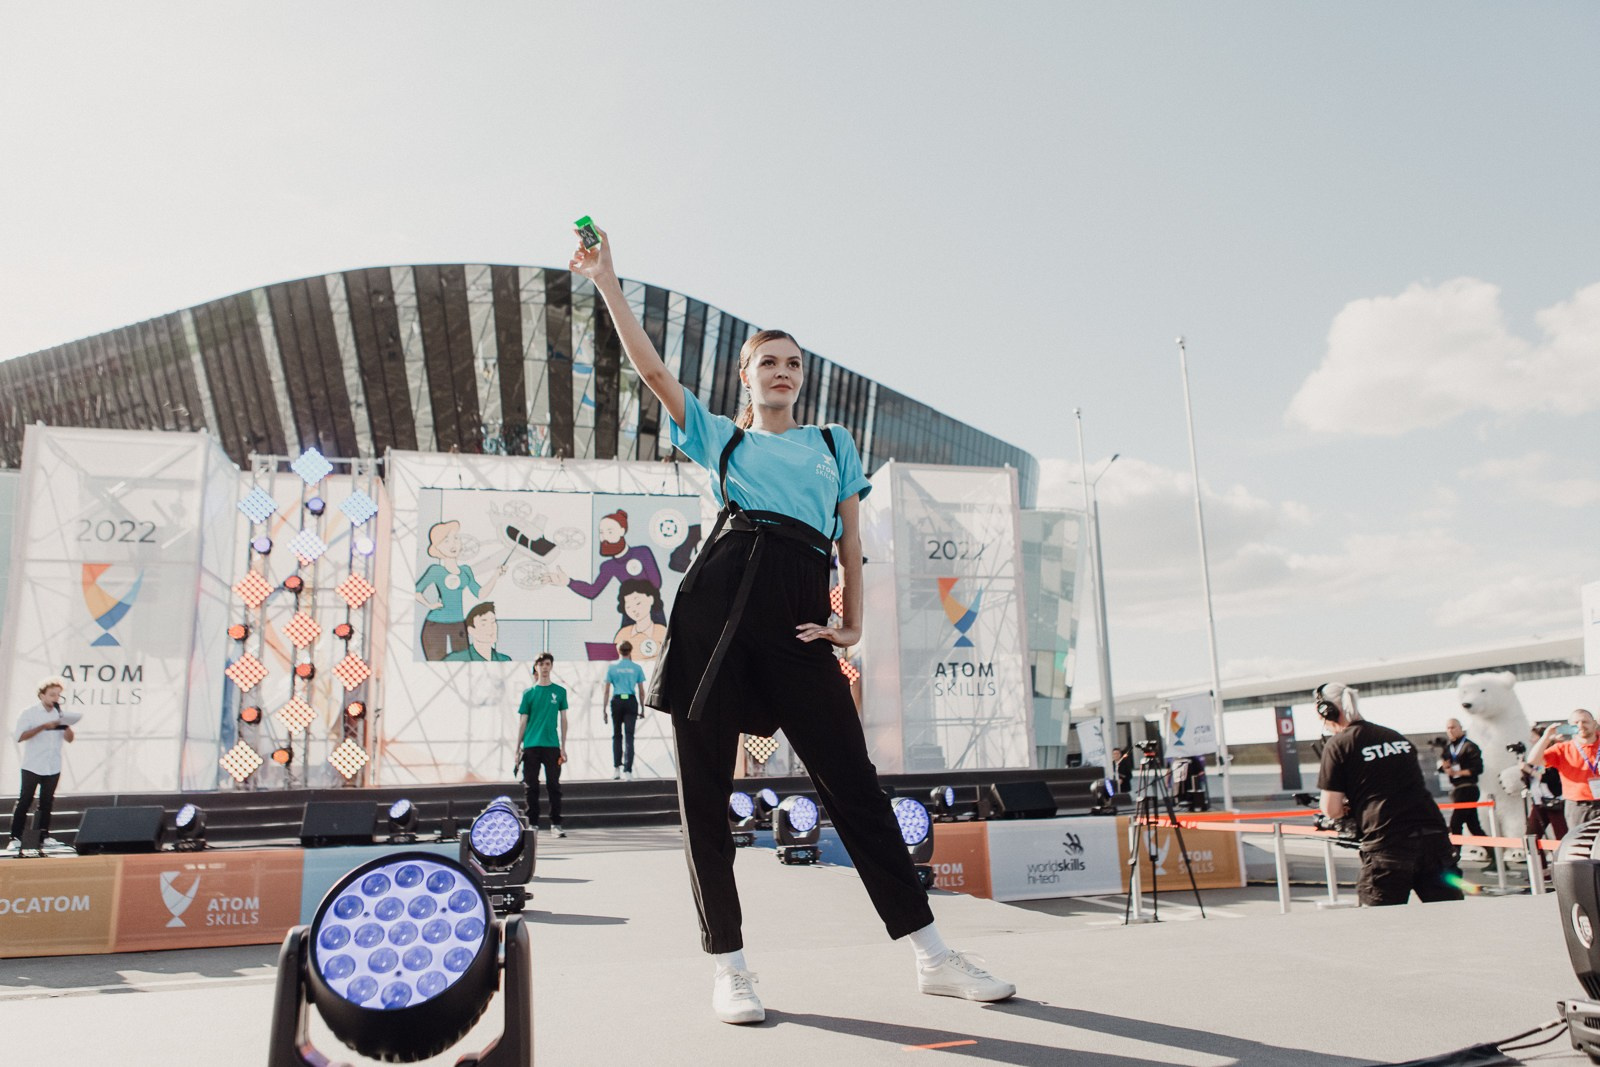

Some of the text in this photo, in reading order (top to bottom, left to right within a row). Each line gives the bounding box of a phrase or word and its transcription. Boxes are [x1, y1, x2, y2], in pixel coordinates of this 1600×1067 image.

[815, 468, 836, 483] SKILLS
[76, 519, 156, 543] 2022
[61, 664, 143, 682] ATOM
[934, 662, 994, 677] ATOM
[934, 681, 996, 697] SKILLS
[1281, 718, 1294, 734] D
[1361, 740, 1412, 762] STAFF
[932, 863, 964, 875] TOM
[1027, 858, 1086, 873] worldskills
[0, 895, 91, 915] ОСАТОМ
[207, 896, 260, 911] ATOM
[206, 911, 260, 926] SKILLS
